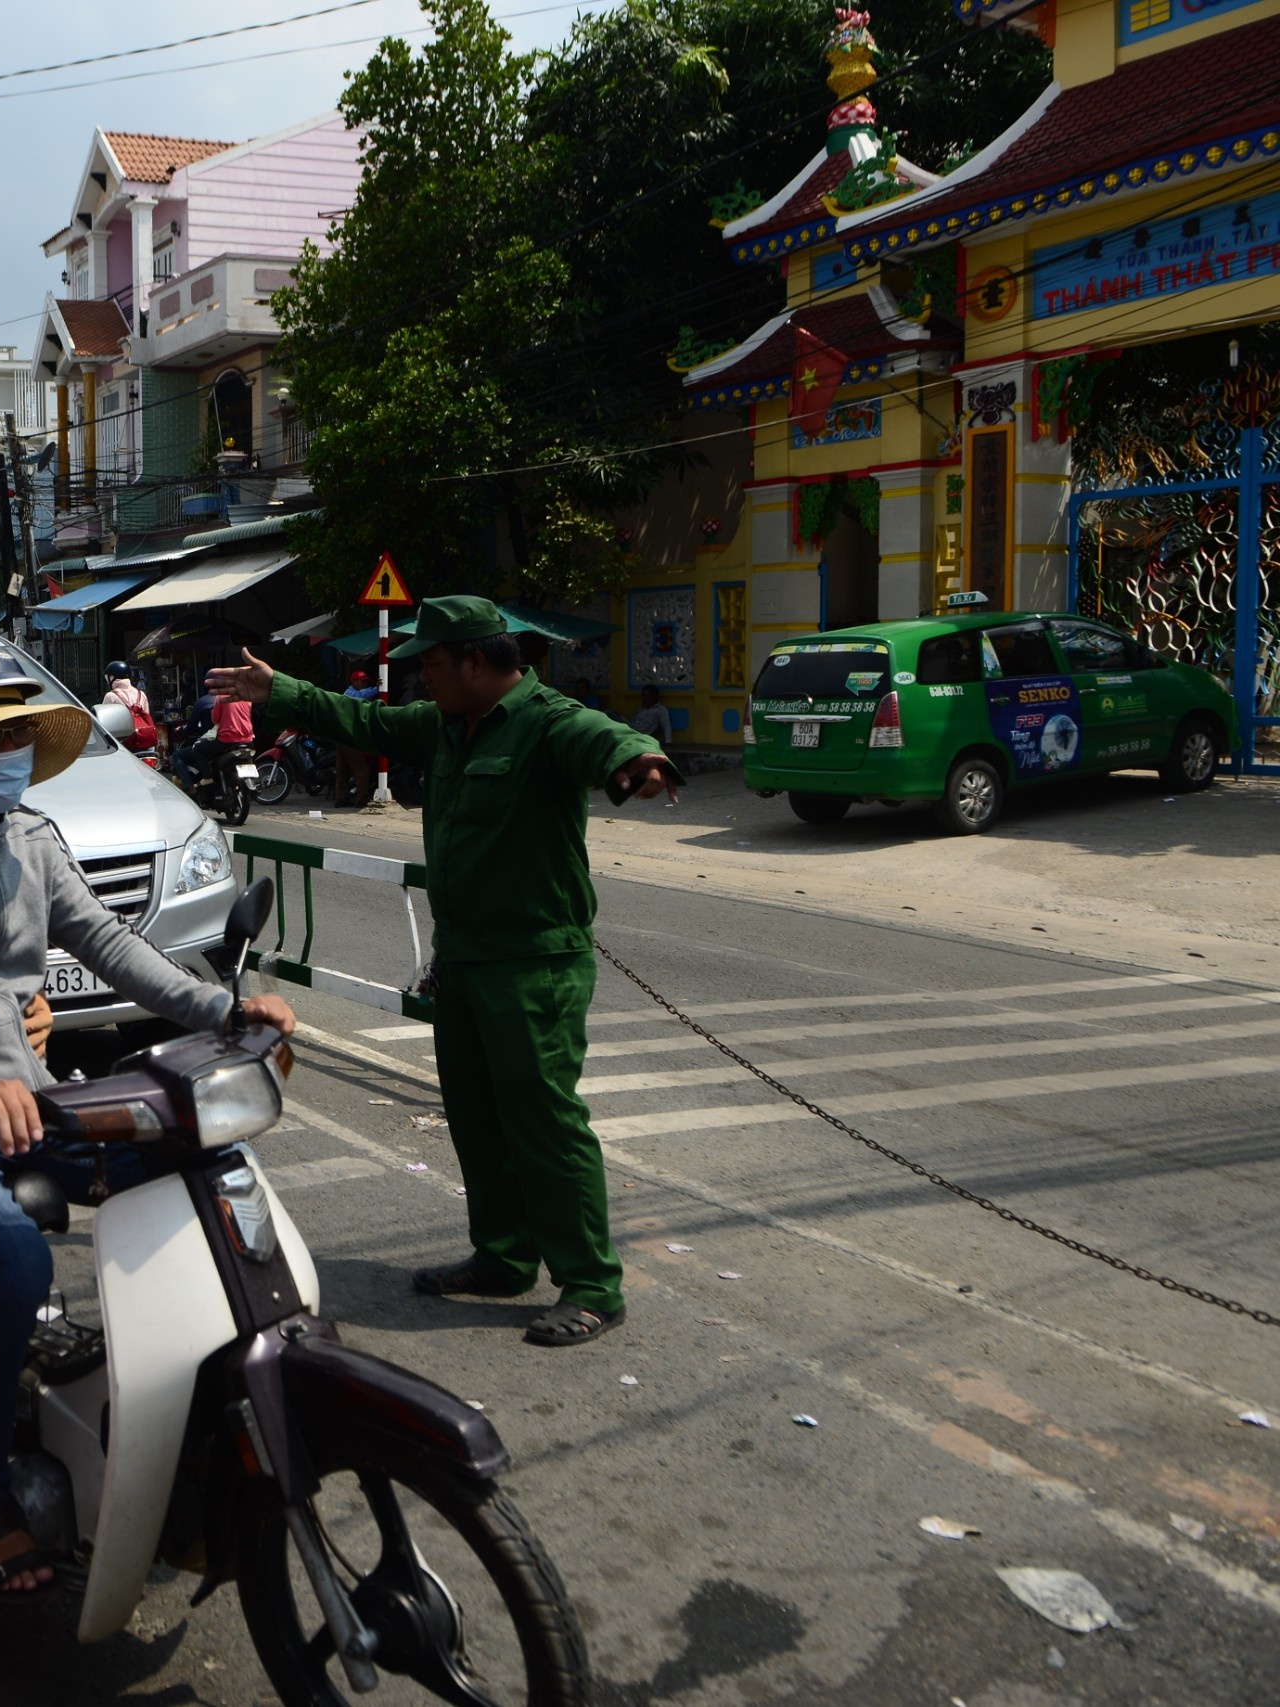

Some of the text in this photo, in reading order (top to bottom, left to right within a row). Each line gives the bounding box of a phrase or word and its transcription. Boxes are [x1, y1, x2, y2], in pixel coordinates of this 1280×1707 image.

[1043, 272, 1144, 314] THÁNH
[1151, 246, 1238, 293] THẤT
[952, 594, 974, 604] TAXI
[1018, 686, 1071, 703] SENKO
[752, 702, 766, 712] TAXI
[829, 702, 839, 712] 38
[840, 702, 850, 712] 38
[851, 702, 862, 712] 38
[863, 702, 876, 712] 38
[1016, 714, 1045, 729] F23
[799, 723, 814, 734] 60A
[792, 735, 819, 746] 031.72
[43, 966, 114, 995] 463.1
